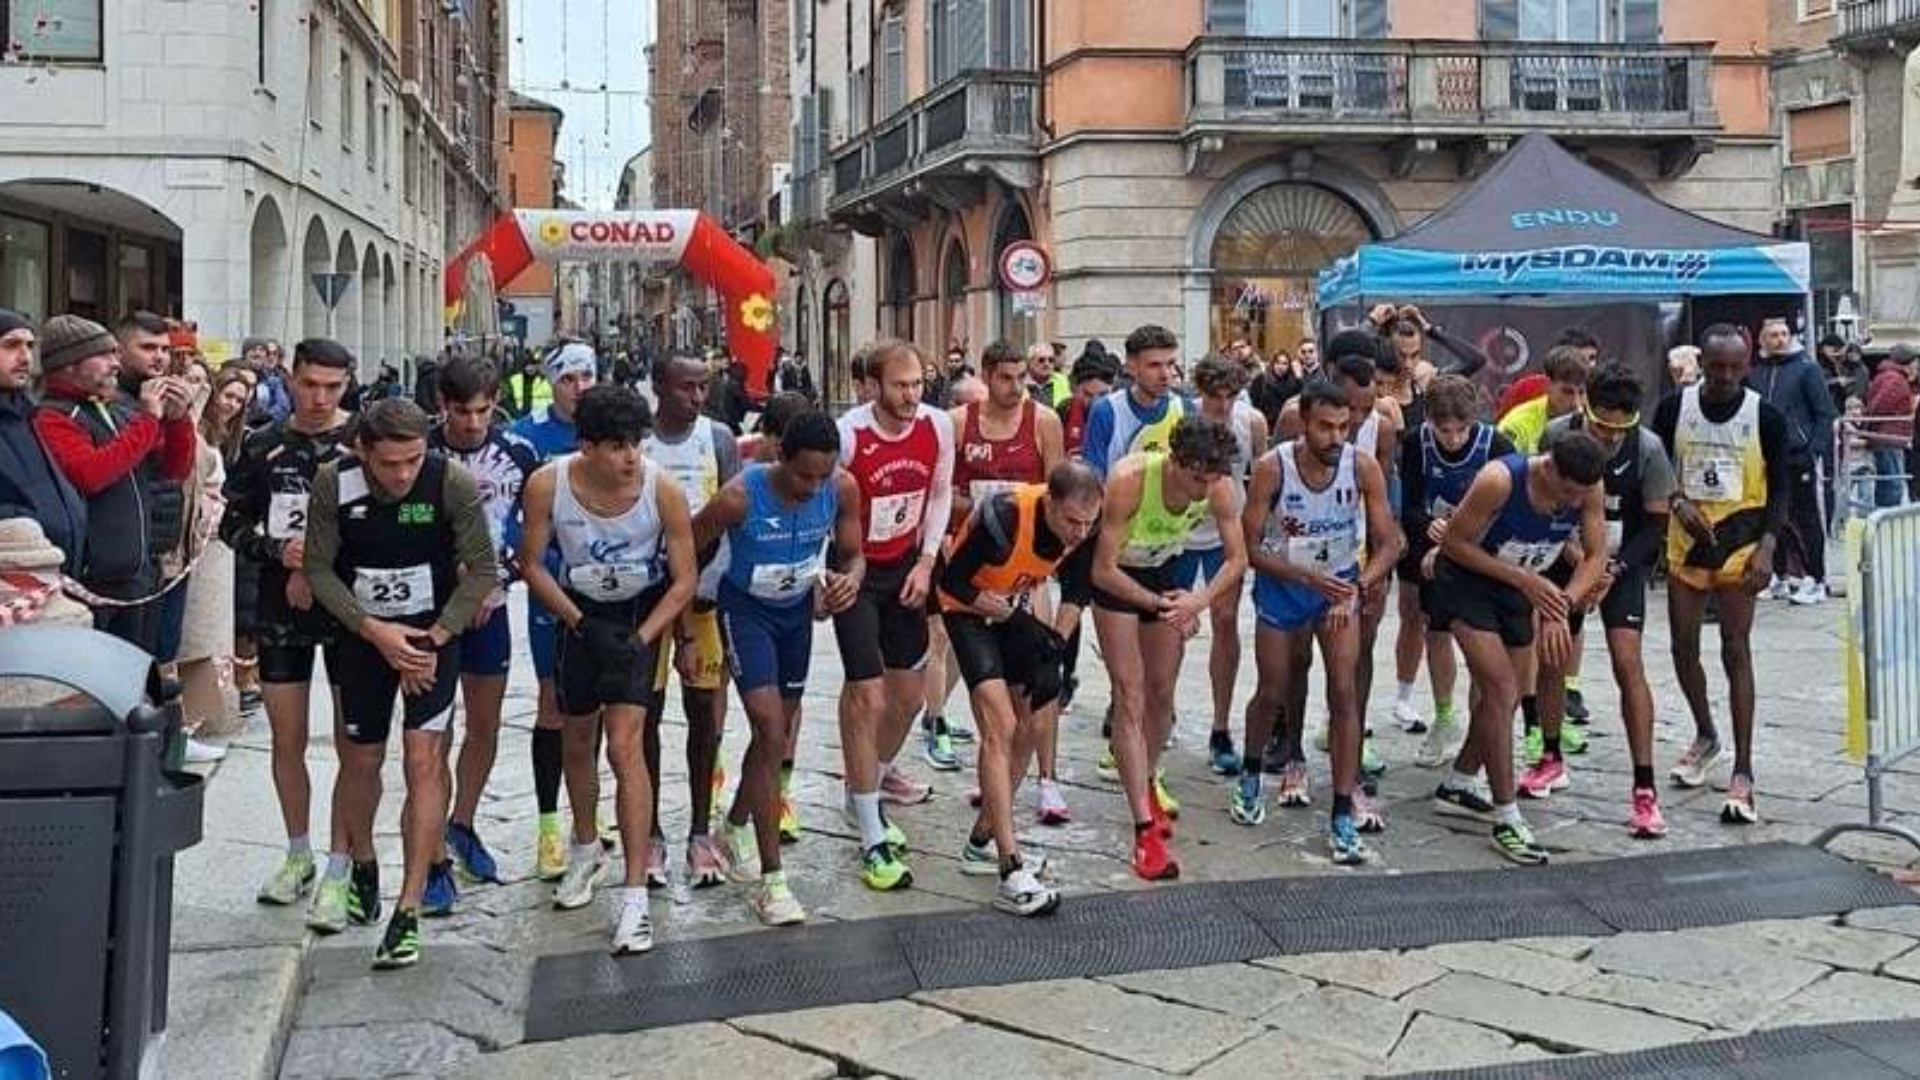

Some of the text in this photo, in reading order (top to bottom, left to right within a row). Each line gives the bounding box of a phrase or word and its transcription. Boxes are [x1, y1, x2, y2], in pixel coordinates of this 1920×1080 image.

[1511, 208, 1620, 231] ENDU
[570, 220, 675, 243] CONAD
[1704, 470, 1719, 487] 8
[894, 505, 908, 524] 6
[1315, 548, 1329, 562] 4
[371, 582, 411, 601] 23
[601, 576, 618, 591] 3
[779, 576, 797, 591] 2
